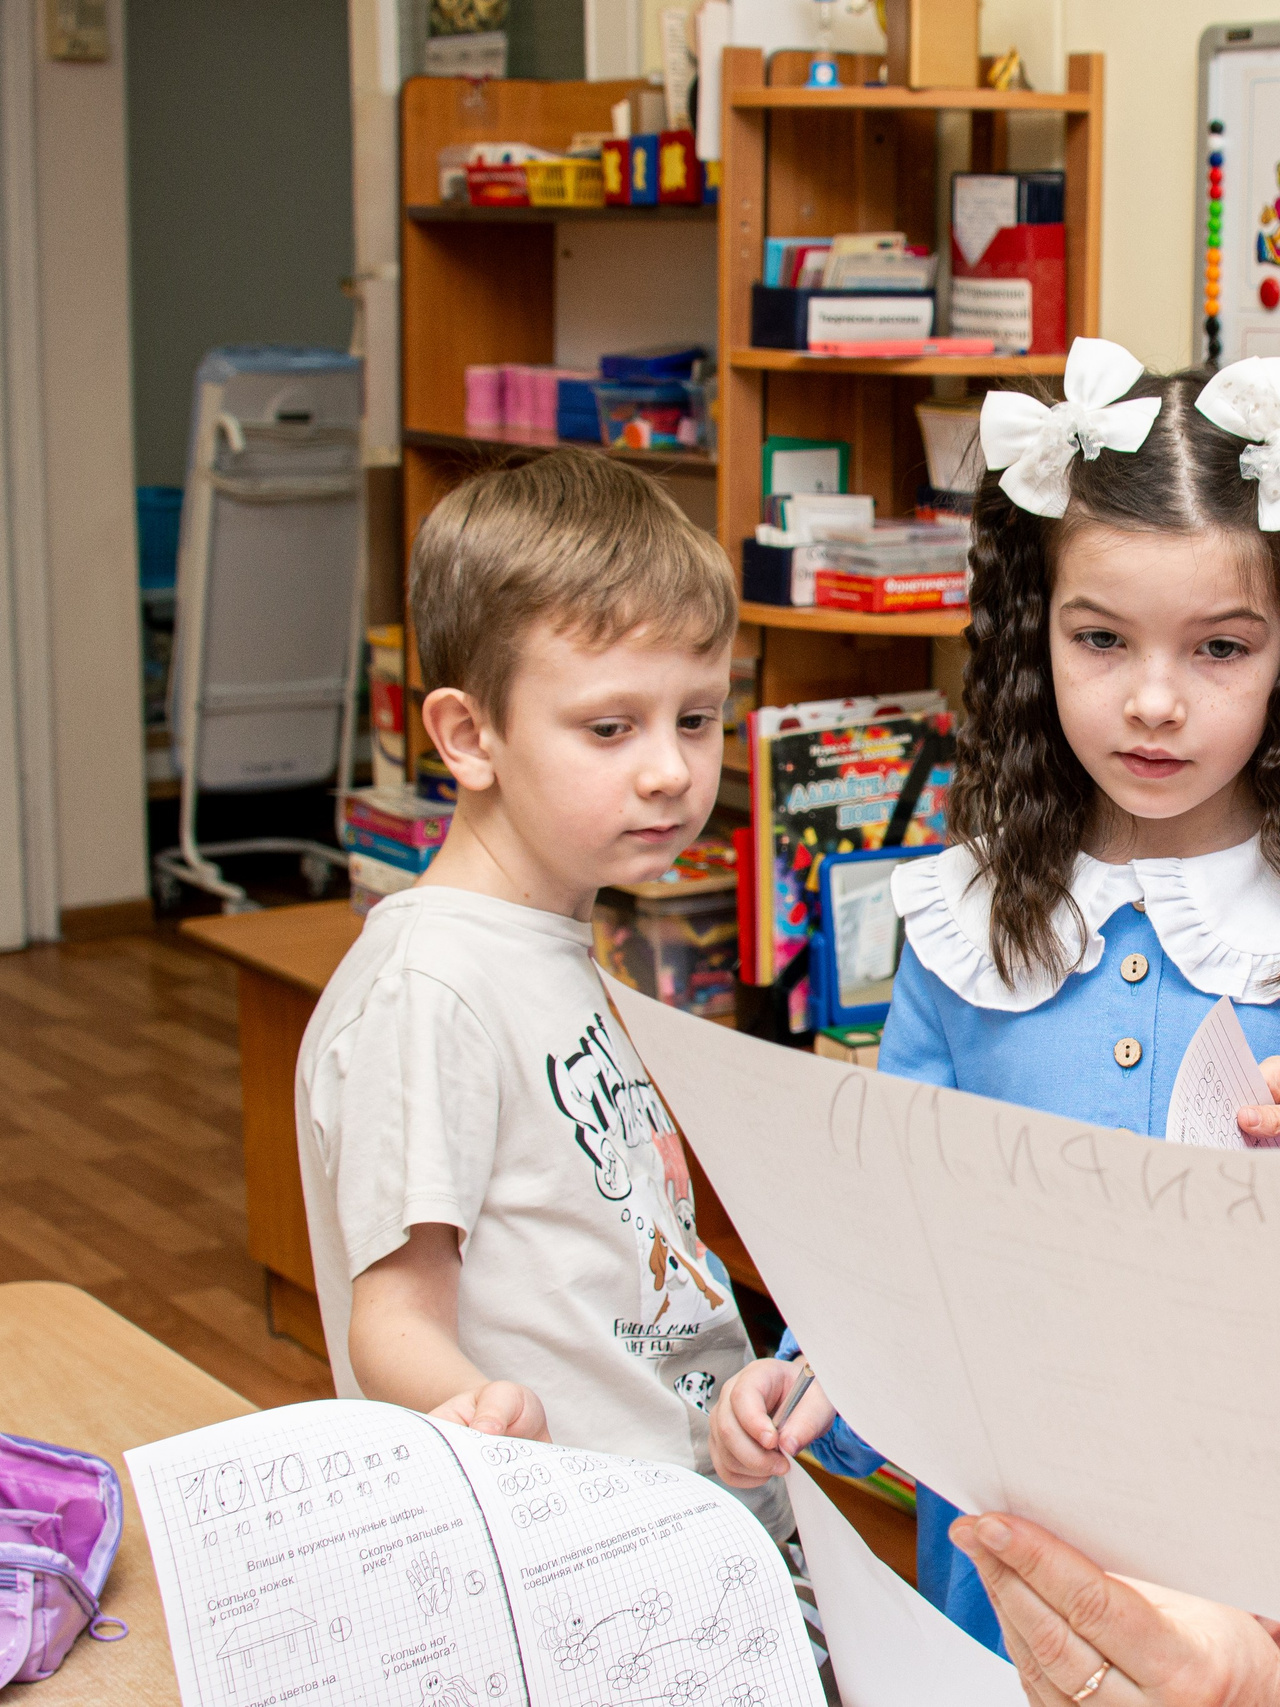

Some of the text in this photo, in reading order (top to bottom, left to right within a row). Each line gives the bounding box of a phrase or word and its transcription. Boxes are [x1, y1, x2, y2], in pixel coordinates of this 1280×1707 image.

[614, 1317, 702, 1337] FRIENDS MAKE
[651, 1340, 676, 1353] FUN
[247, 1506, 428, 1572] Впиши в кружочки нужные цифры.
[359, 1516, 464, 1560] Сколько пальцев на
[520, 1558, 558, 1580] Помоги
[560, 1545, 593, 1565] пчёлке
[595, 1525, 647, 1551] перелететь
[648, 1522, 654, 1531] с
[655, 1512, 682, 1528] цветка
[683, 1507, 694, 1519] на
[362, 1552, 392, 1574] руке?
[523, 1567, 572, 1591] соединяя
[573, 1560, 584, 1573] их
[586, 1556, 599, 1569] по
[600, 1541, 638, 1563] порядку
[639, 1535, 651, 1547] от
[659, 1528, 671, 1541] до
[671, 1521, 686, 1535] 10.
[207, 1575, 295, 1612] Сколько ножек
[209, 1597, 260, 1627] у стола?
[381, 1634, 448, 1665] Сколько ног
[383, 1642, 457, 1680] у осьминога?
[279, 1679, 319, 1702] цветов
[322, 1674, 337, 1687] на
